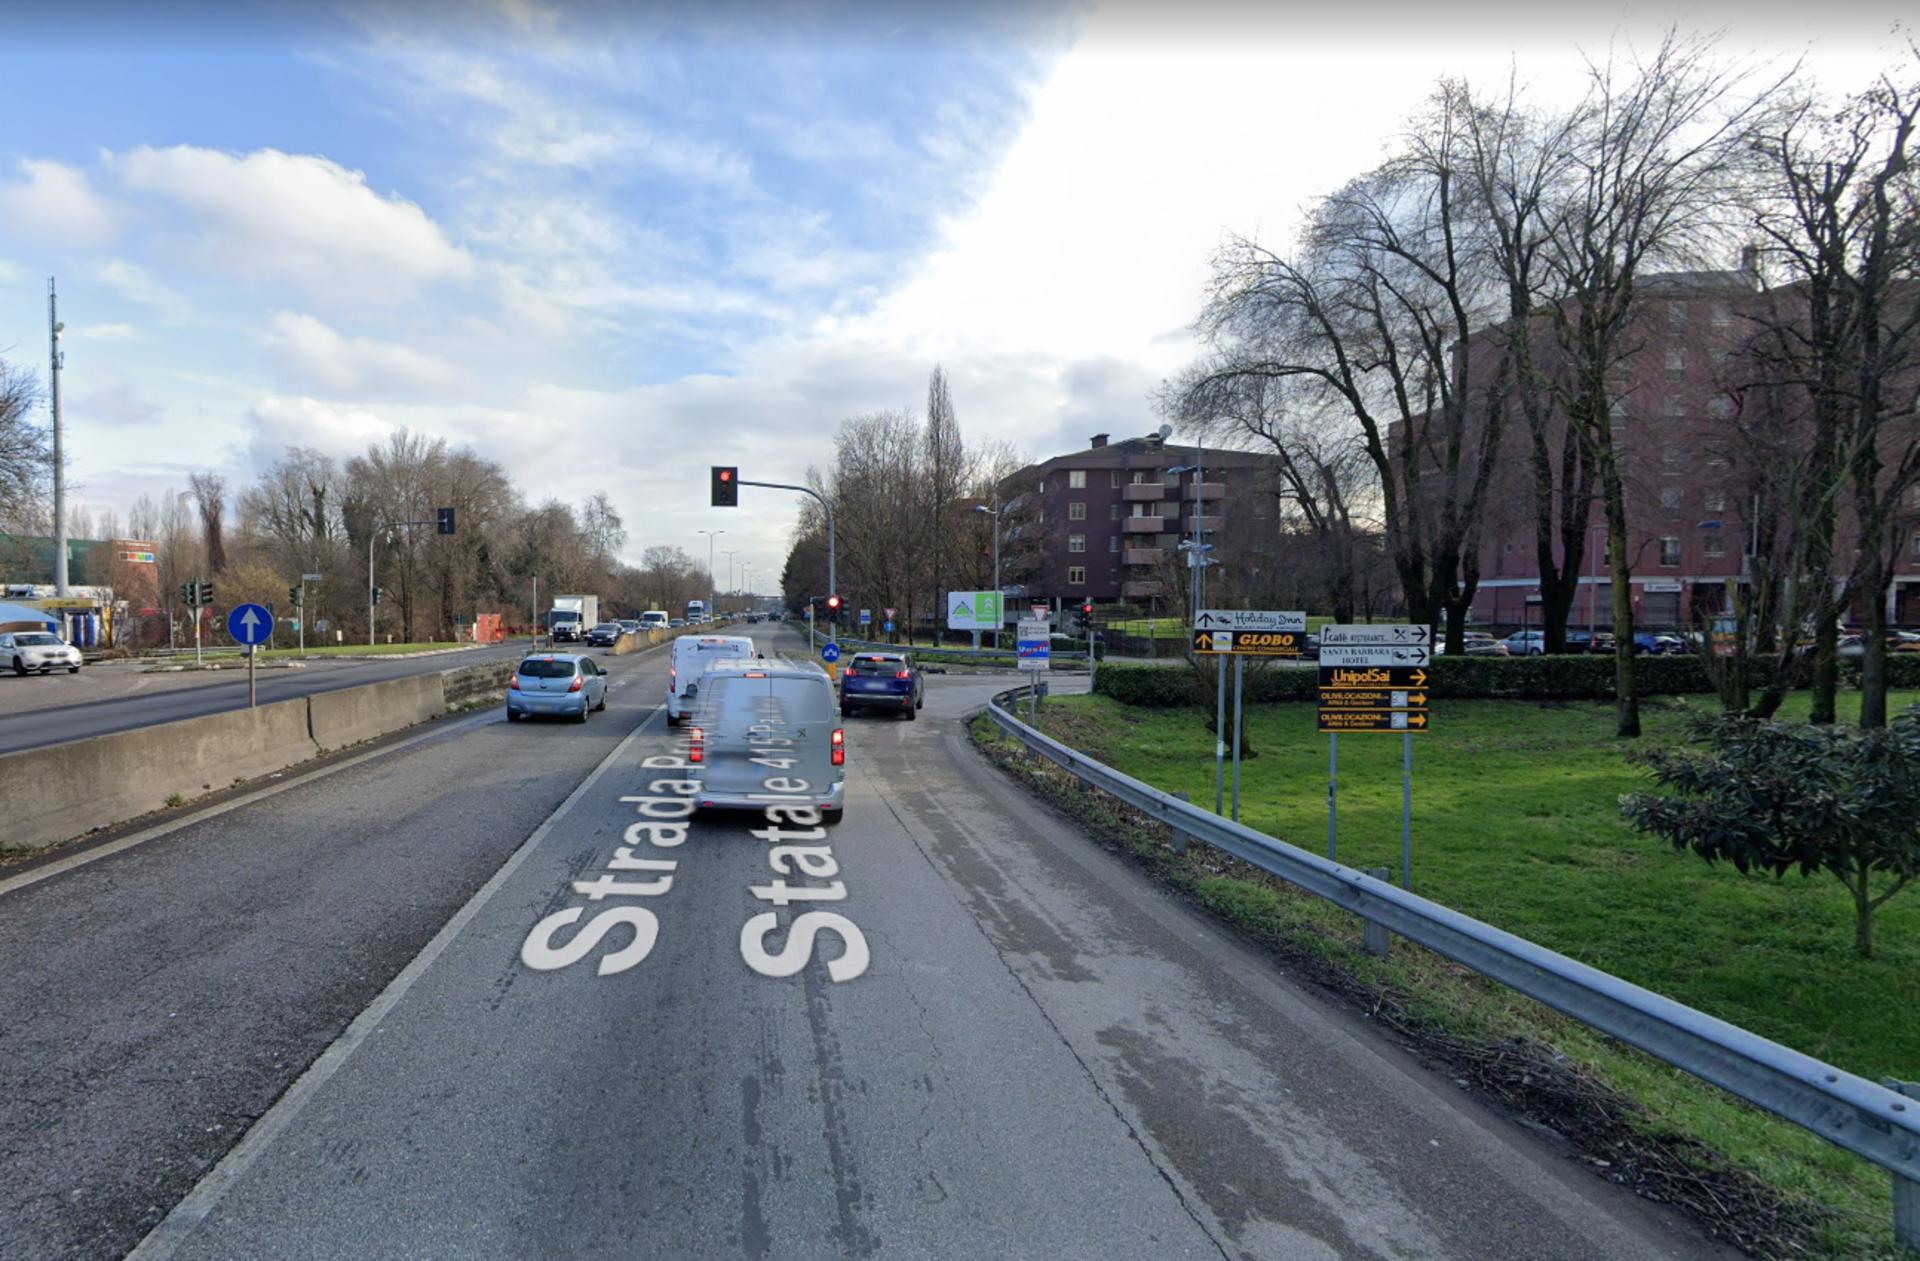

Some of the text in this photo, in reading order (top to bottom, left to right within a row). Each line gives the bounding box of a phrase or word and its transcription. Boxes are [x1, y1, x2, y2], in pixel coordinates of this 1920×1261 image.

[1235, 611, 1303, 626] Holiday Inn
[1239, 633, 1294, 646] GLOBO
[1350, 648, 1390, 656] BARBARA
[1333, 668, 1391, 685] UnipolSai
